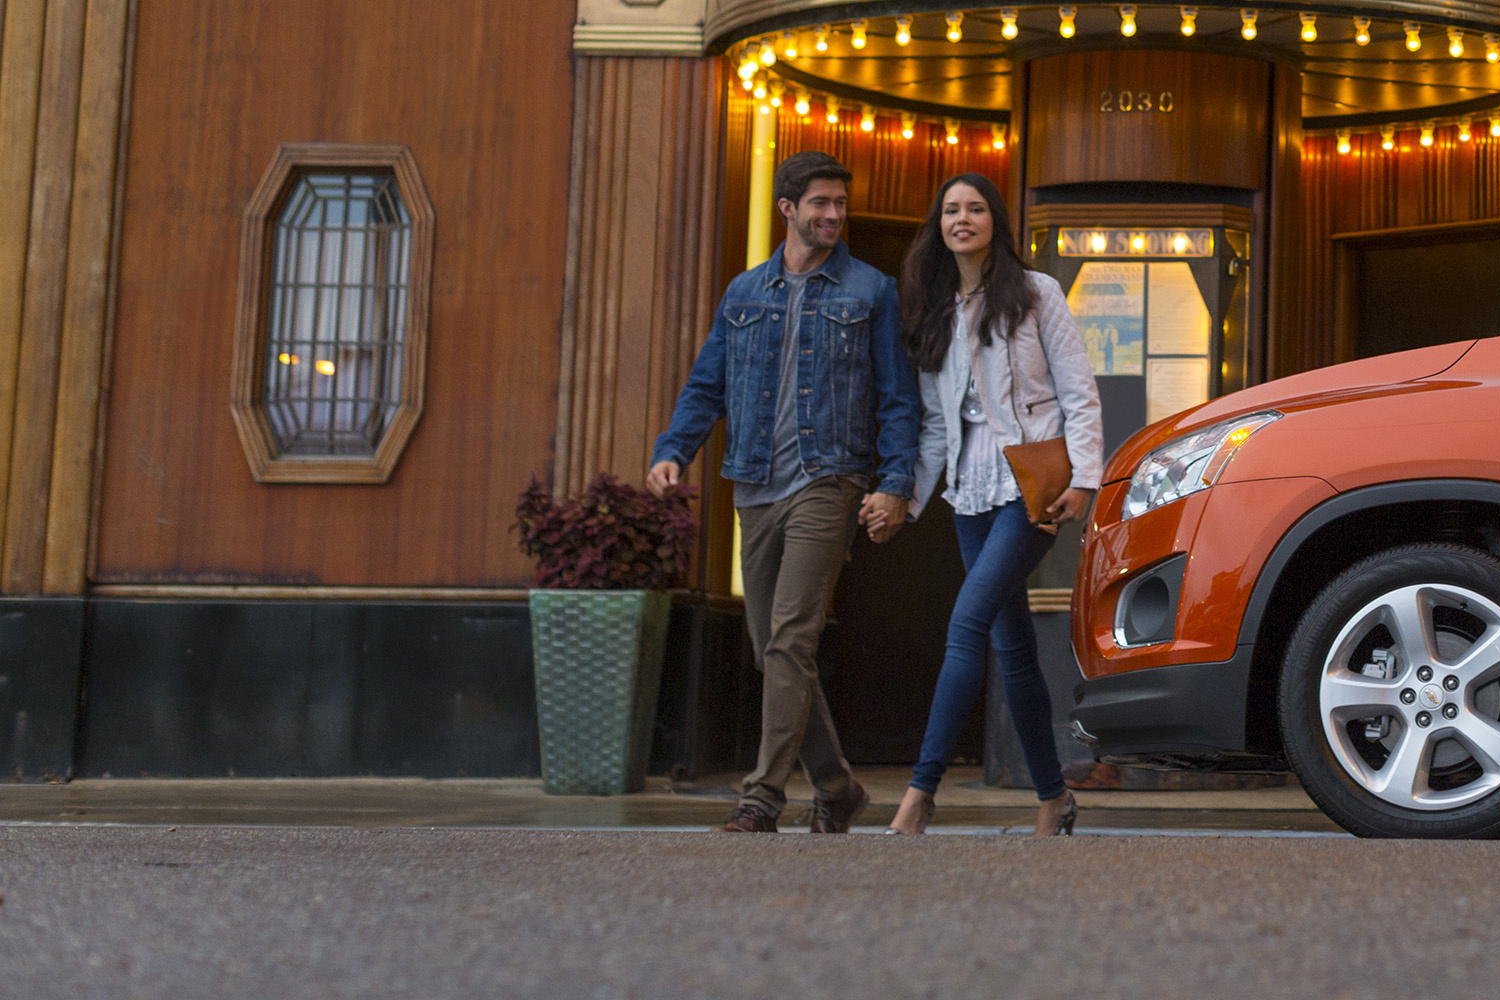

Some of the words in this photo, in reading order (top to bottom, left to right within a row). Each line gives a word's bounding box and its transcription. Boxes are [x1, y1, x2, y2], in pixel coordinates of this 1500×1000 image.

[1100, 90, 1173, 112] 2030
[1063, 230, 1109, 255] NOW
[1114, 230, 1209, 255] SHOWNG
